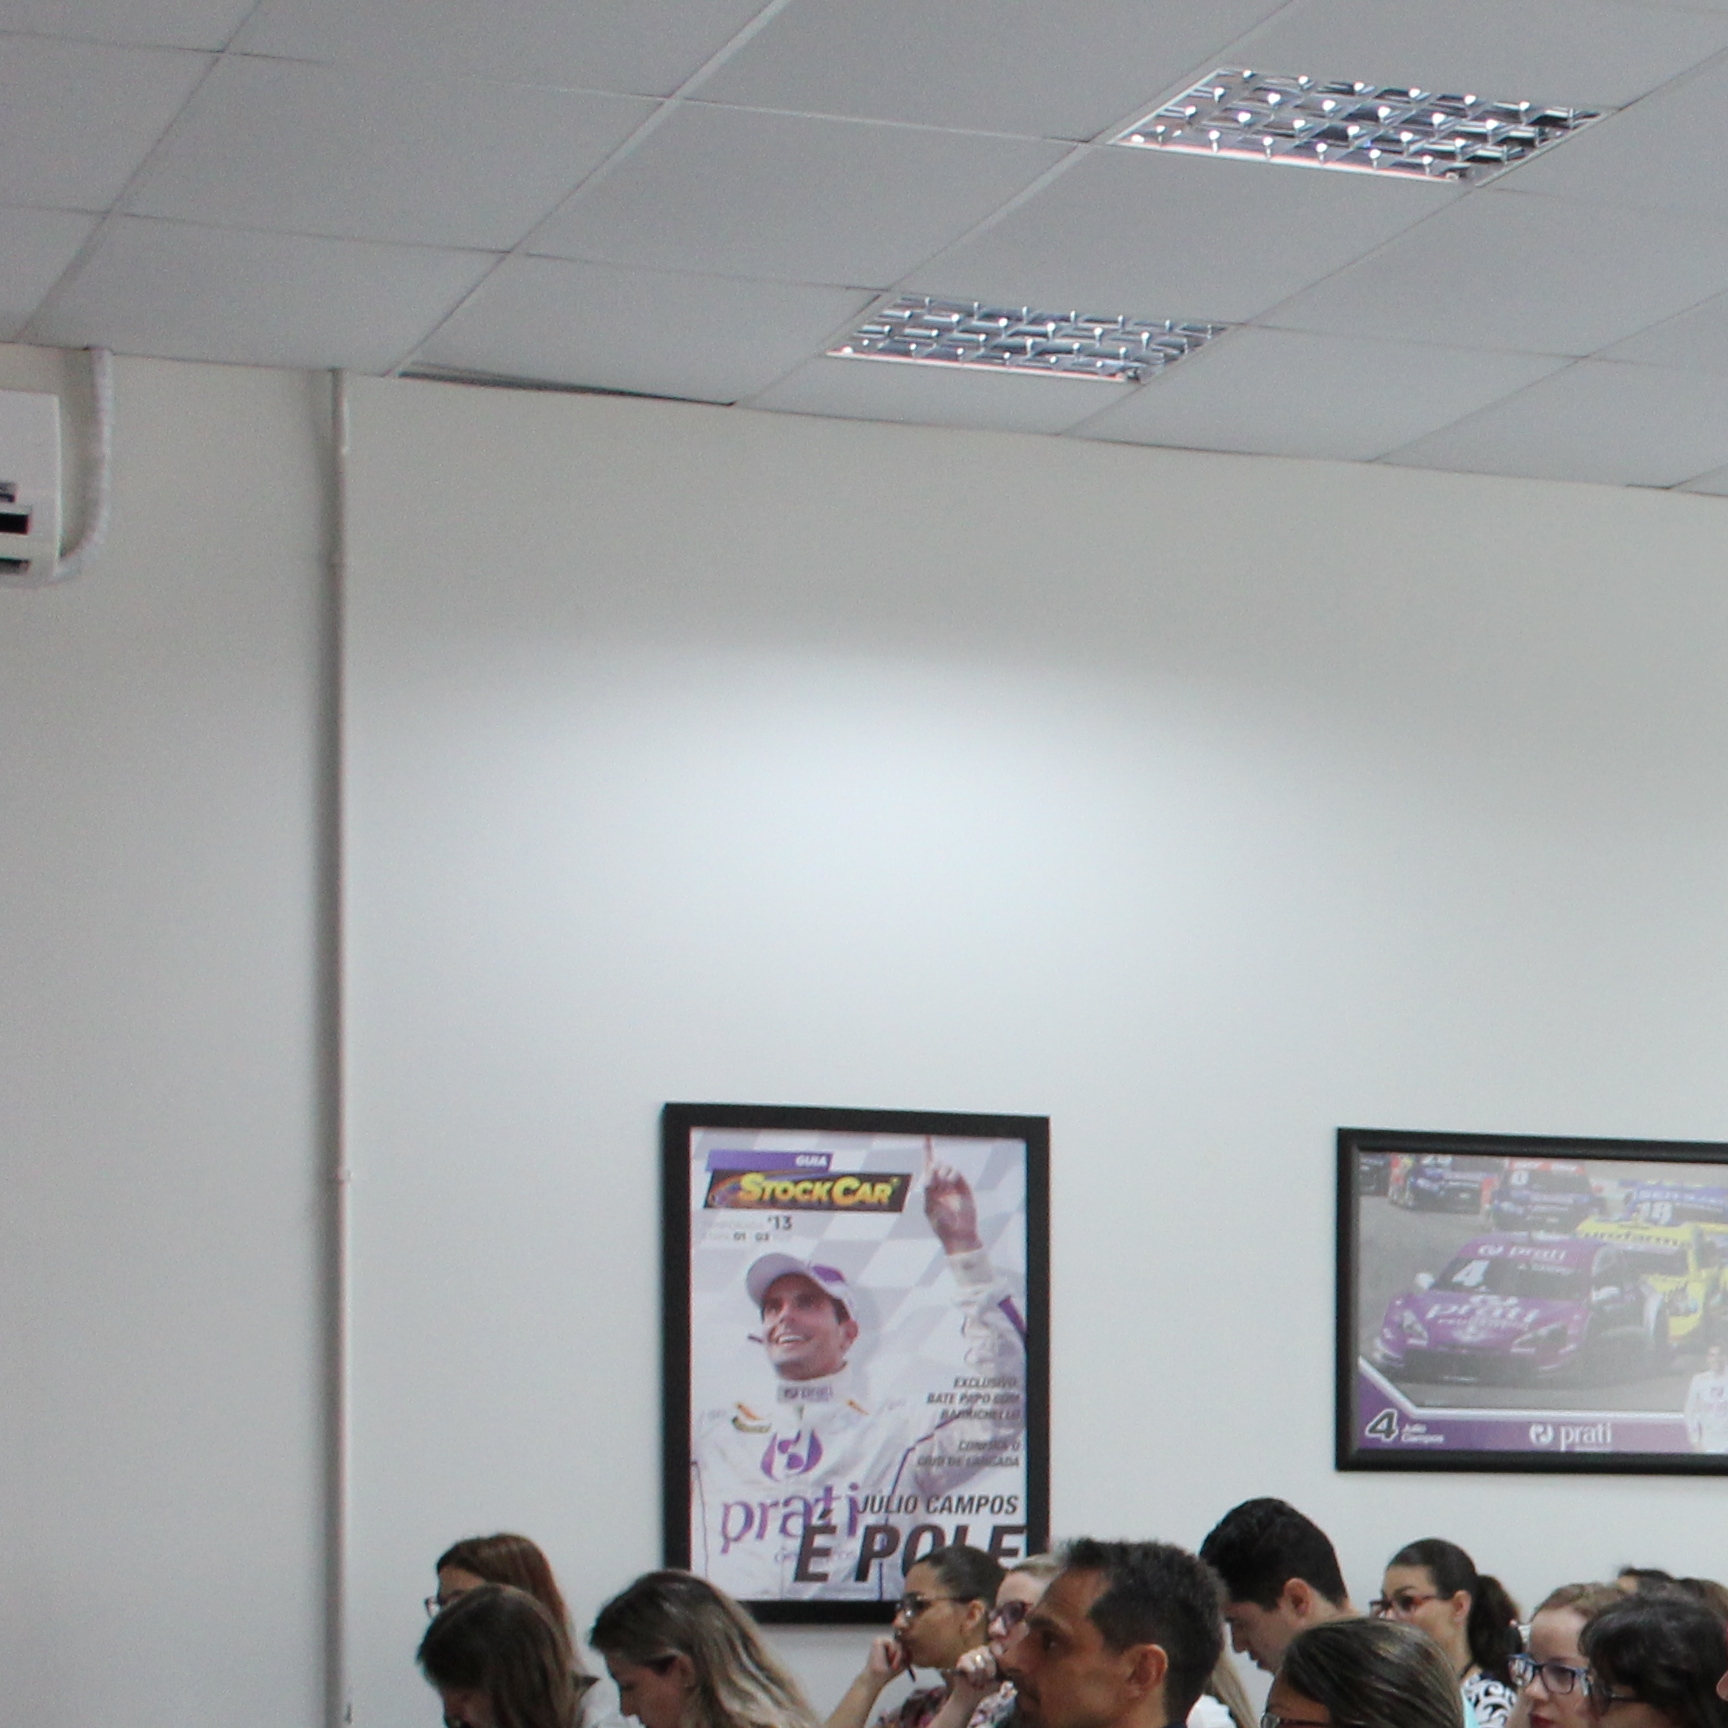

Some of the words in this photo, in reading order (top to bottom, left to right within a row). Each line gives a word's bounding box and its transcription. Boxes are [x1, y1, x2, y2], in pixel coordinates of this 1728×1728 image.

[795, 1155, 828, 1168] GUIA
[1365, 1408, 1399, 1444] 4
[1560, 1422, 1612, 1452] prati
[926, 1494, 1018, 1515] CAMPOS
